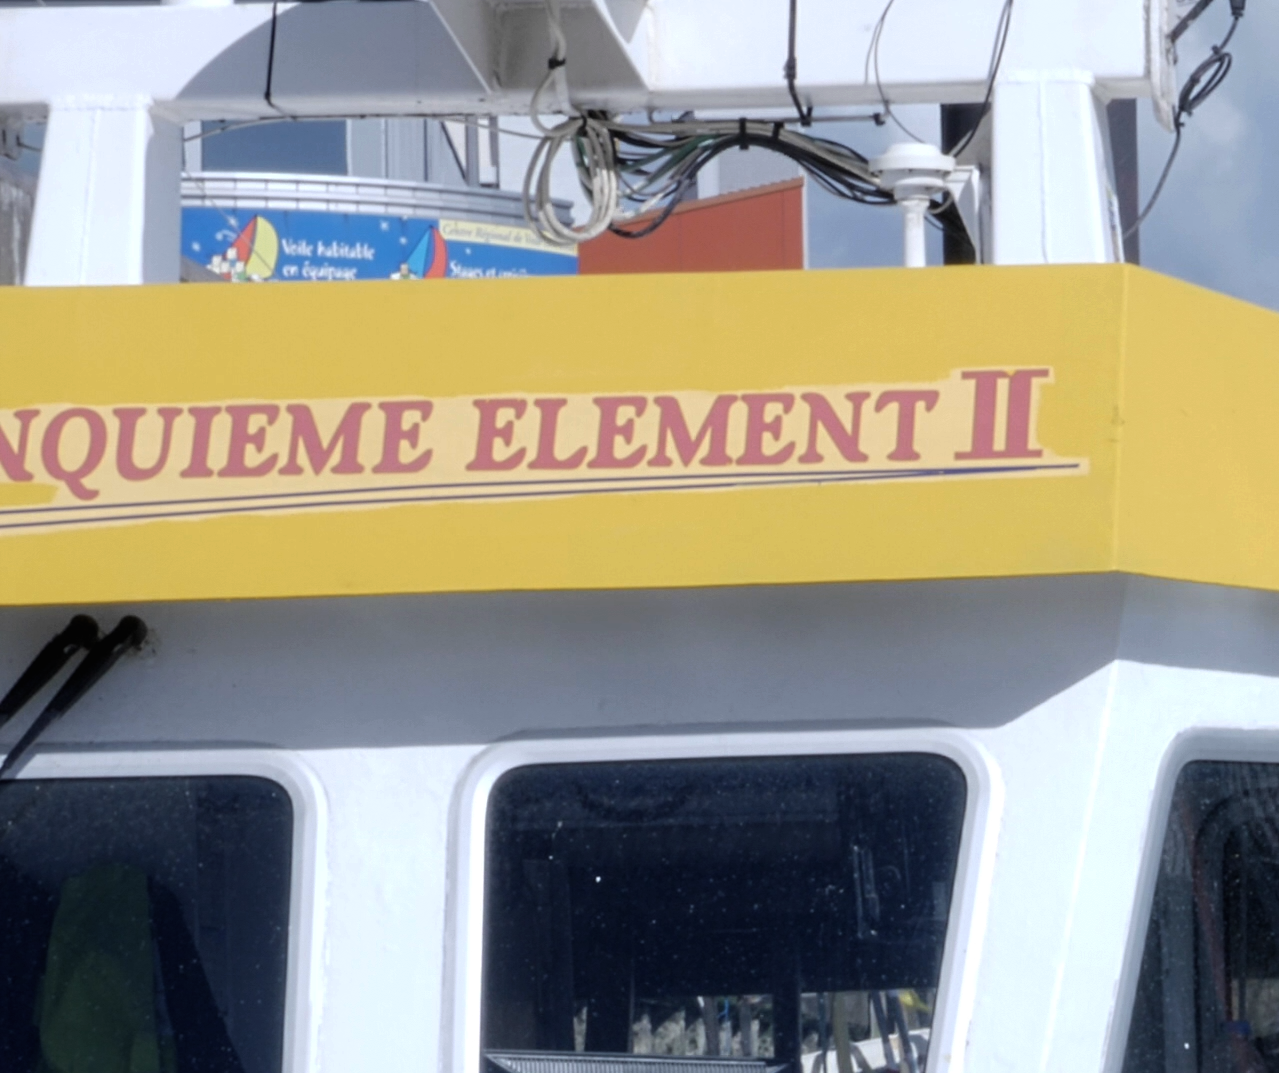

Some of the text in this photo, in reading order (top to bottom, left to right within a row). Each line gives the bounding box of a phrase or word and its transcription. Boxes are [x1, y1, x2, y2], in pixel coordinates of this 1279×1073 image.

[281, 238, 376, 261] Voile habitable
[282, 260, 358, 280] en équipage
[465, 390, 939, 471] ELEMENT
[954, 368, 1049, 461] II
